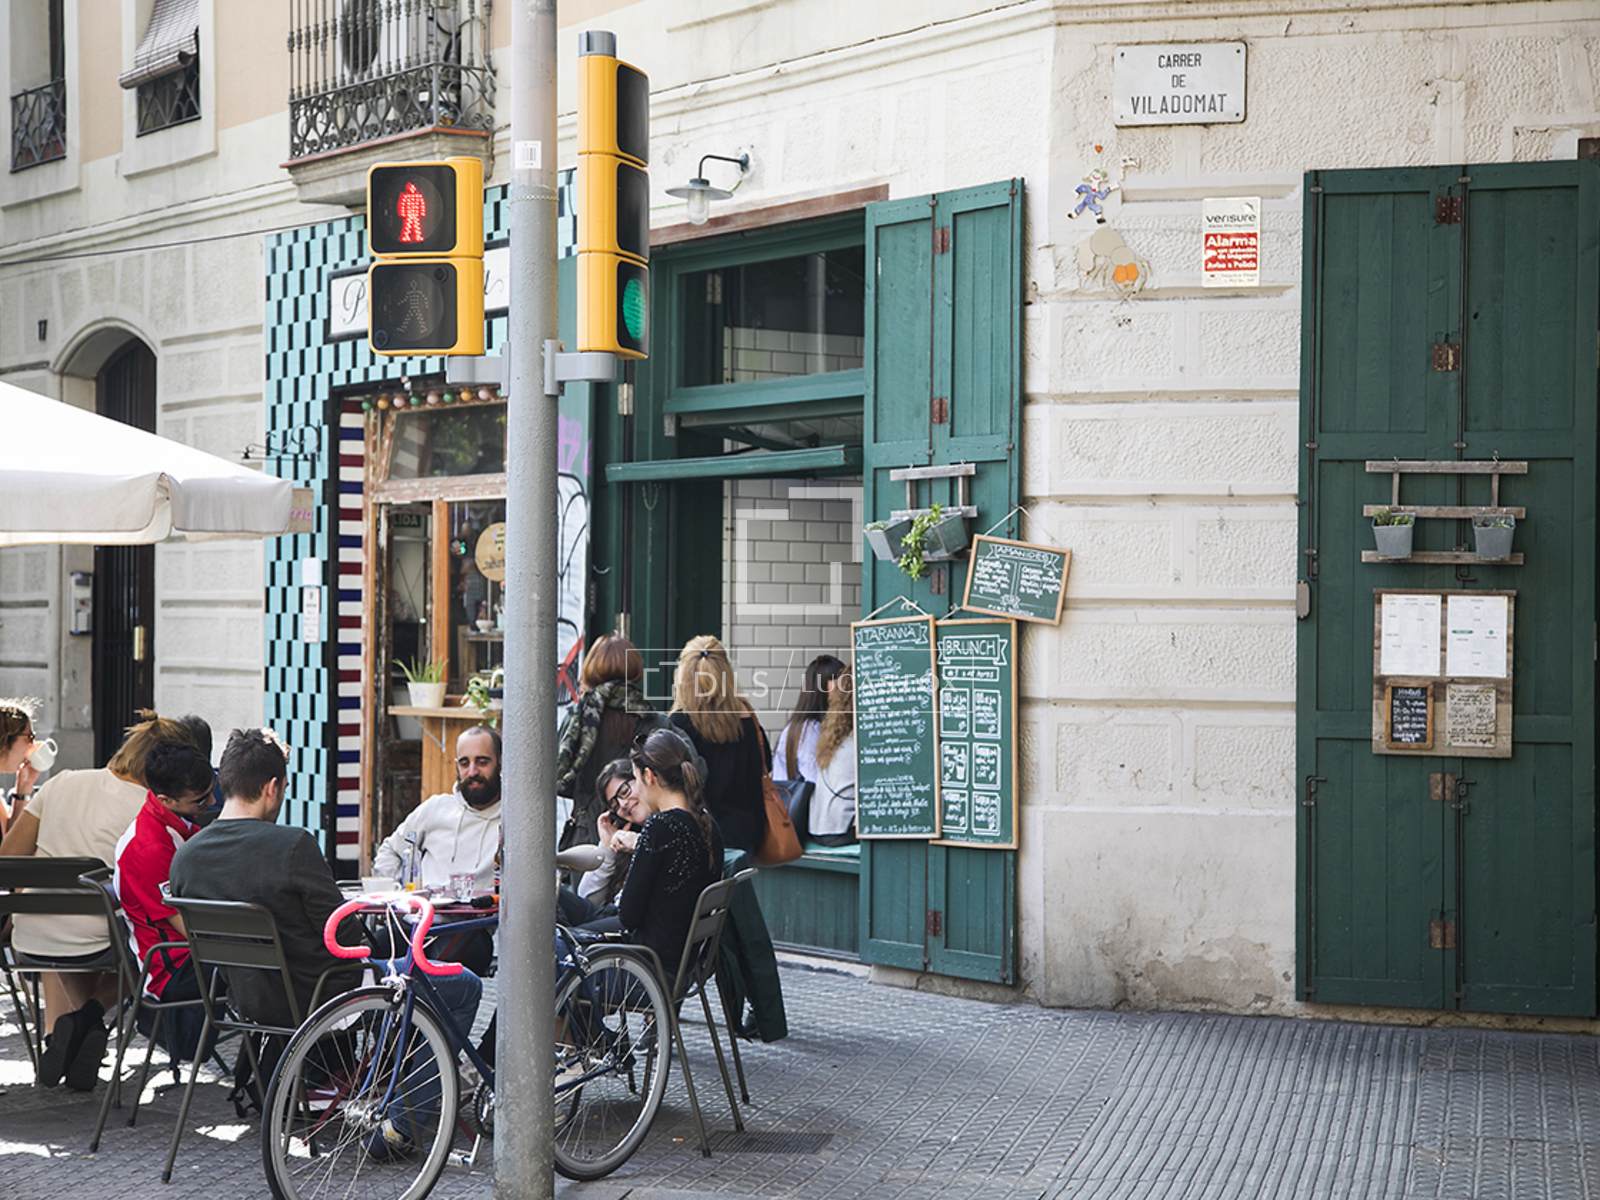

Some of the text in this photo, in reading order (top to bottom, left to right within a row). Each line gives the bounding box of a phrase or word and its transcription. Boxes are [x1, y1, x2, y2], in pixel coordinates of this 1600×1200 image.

[1158, 53, 1202, 68] CARRER
[1171, 74, 1187, 88] DE
[1130, 93, 1228, 115] VILADOMAT
[1205, 214, 1257, 223] verisure
[1206, 235, 1257, 247] Alarma
[946, 640, 996, 656] BRUNCH
